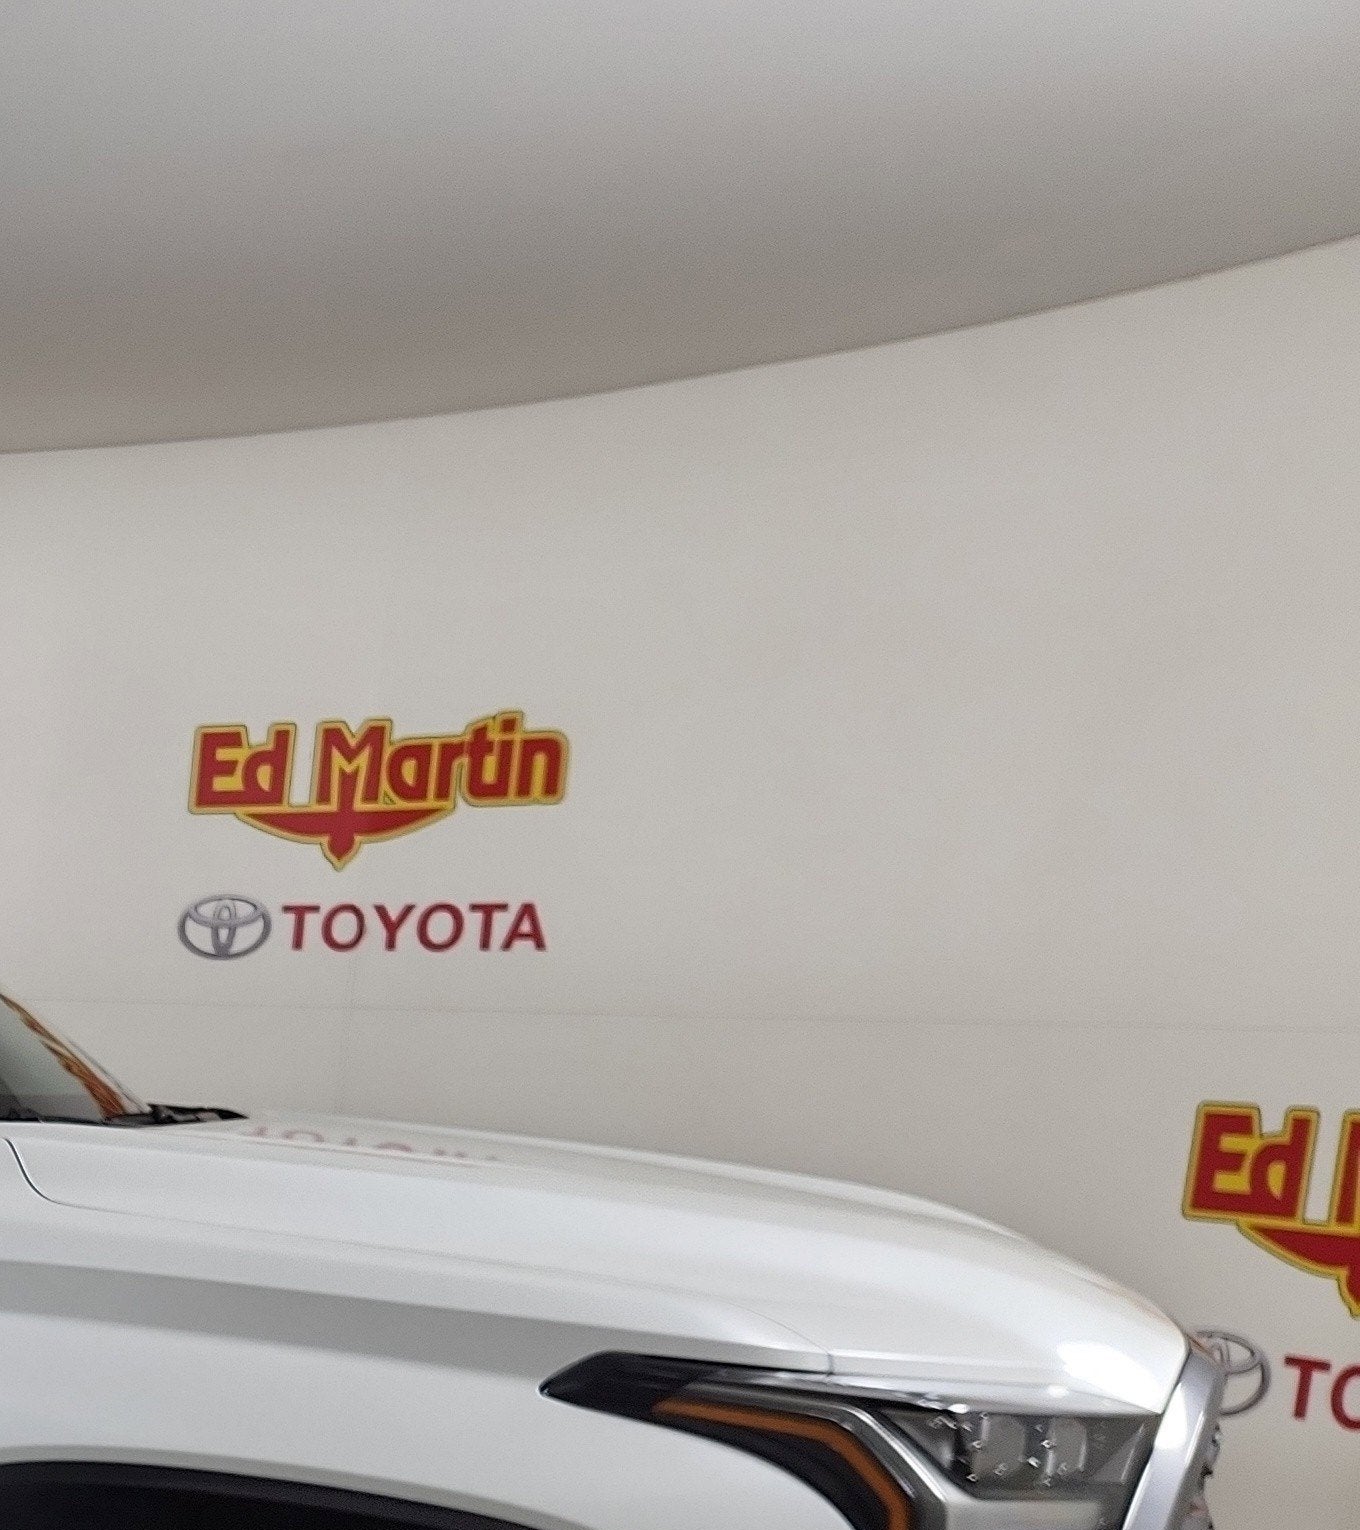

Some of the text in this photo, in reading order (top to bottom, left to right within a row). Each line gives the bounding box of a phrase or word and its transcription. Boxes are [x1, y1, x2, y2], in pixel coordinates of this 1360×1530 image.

[194, 714, 564, 806] Ed Martin
[282, 902, 548, 952] TOYOTA
[1187, 1111, 1313, 1220] Ed
